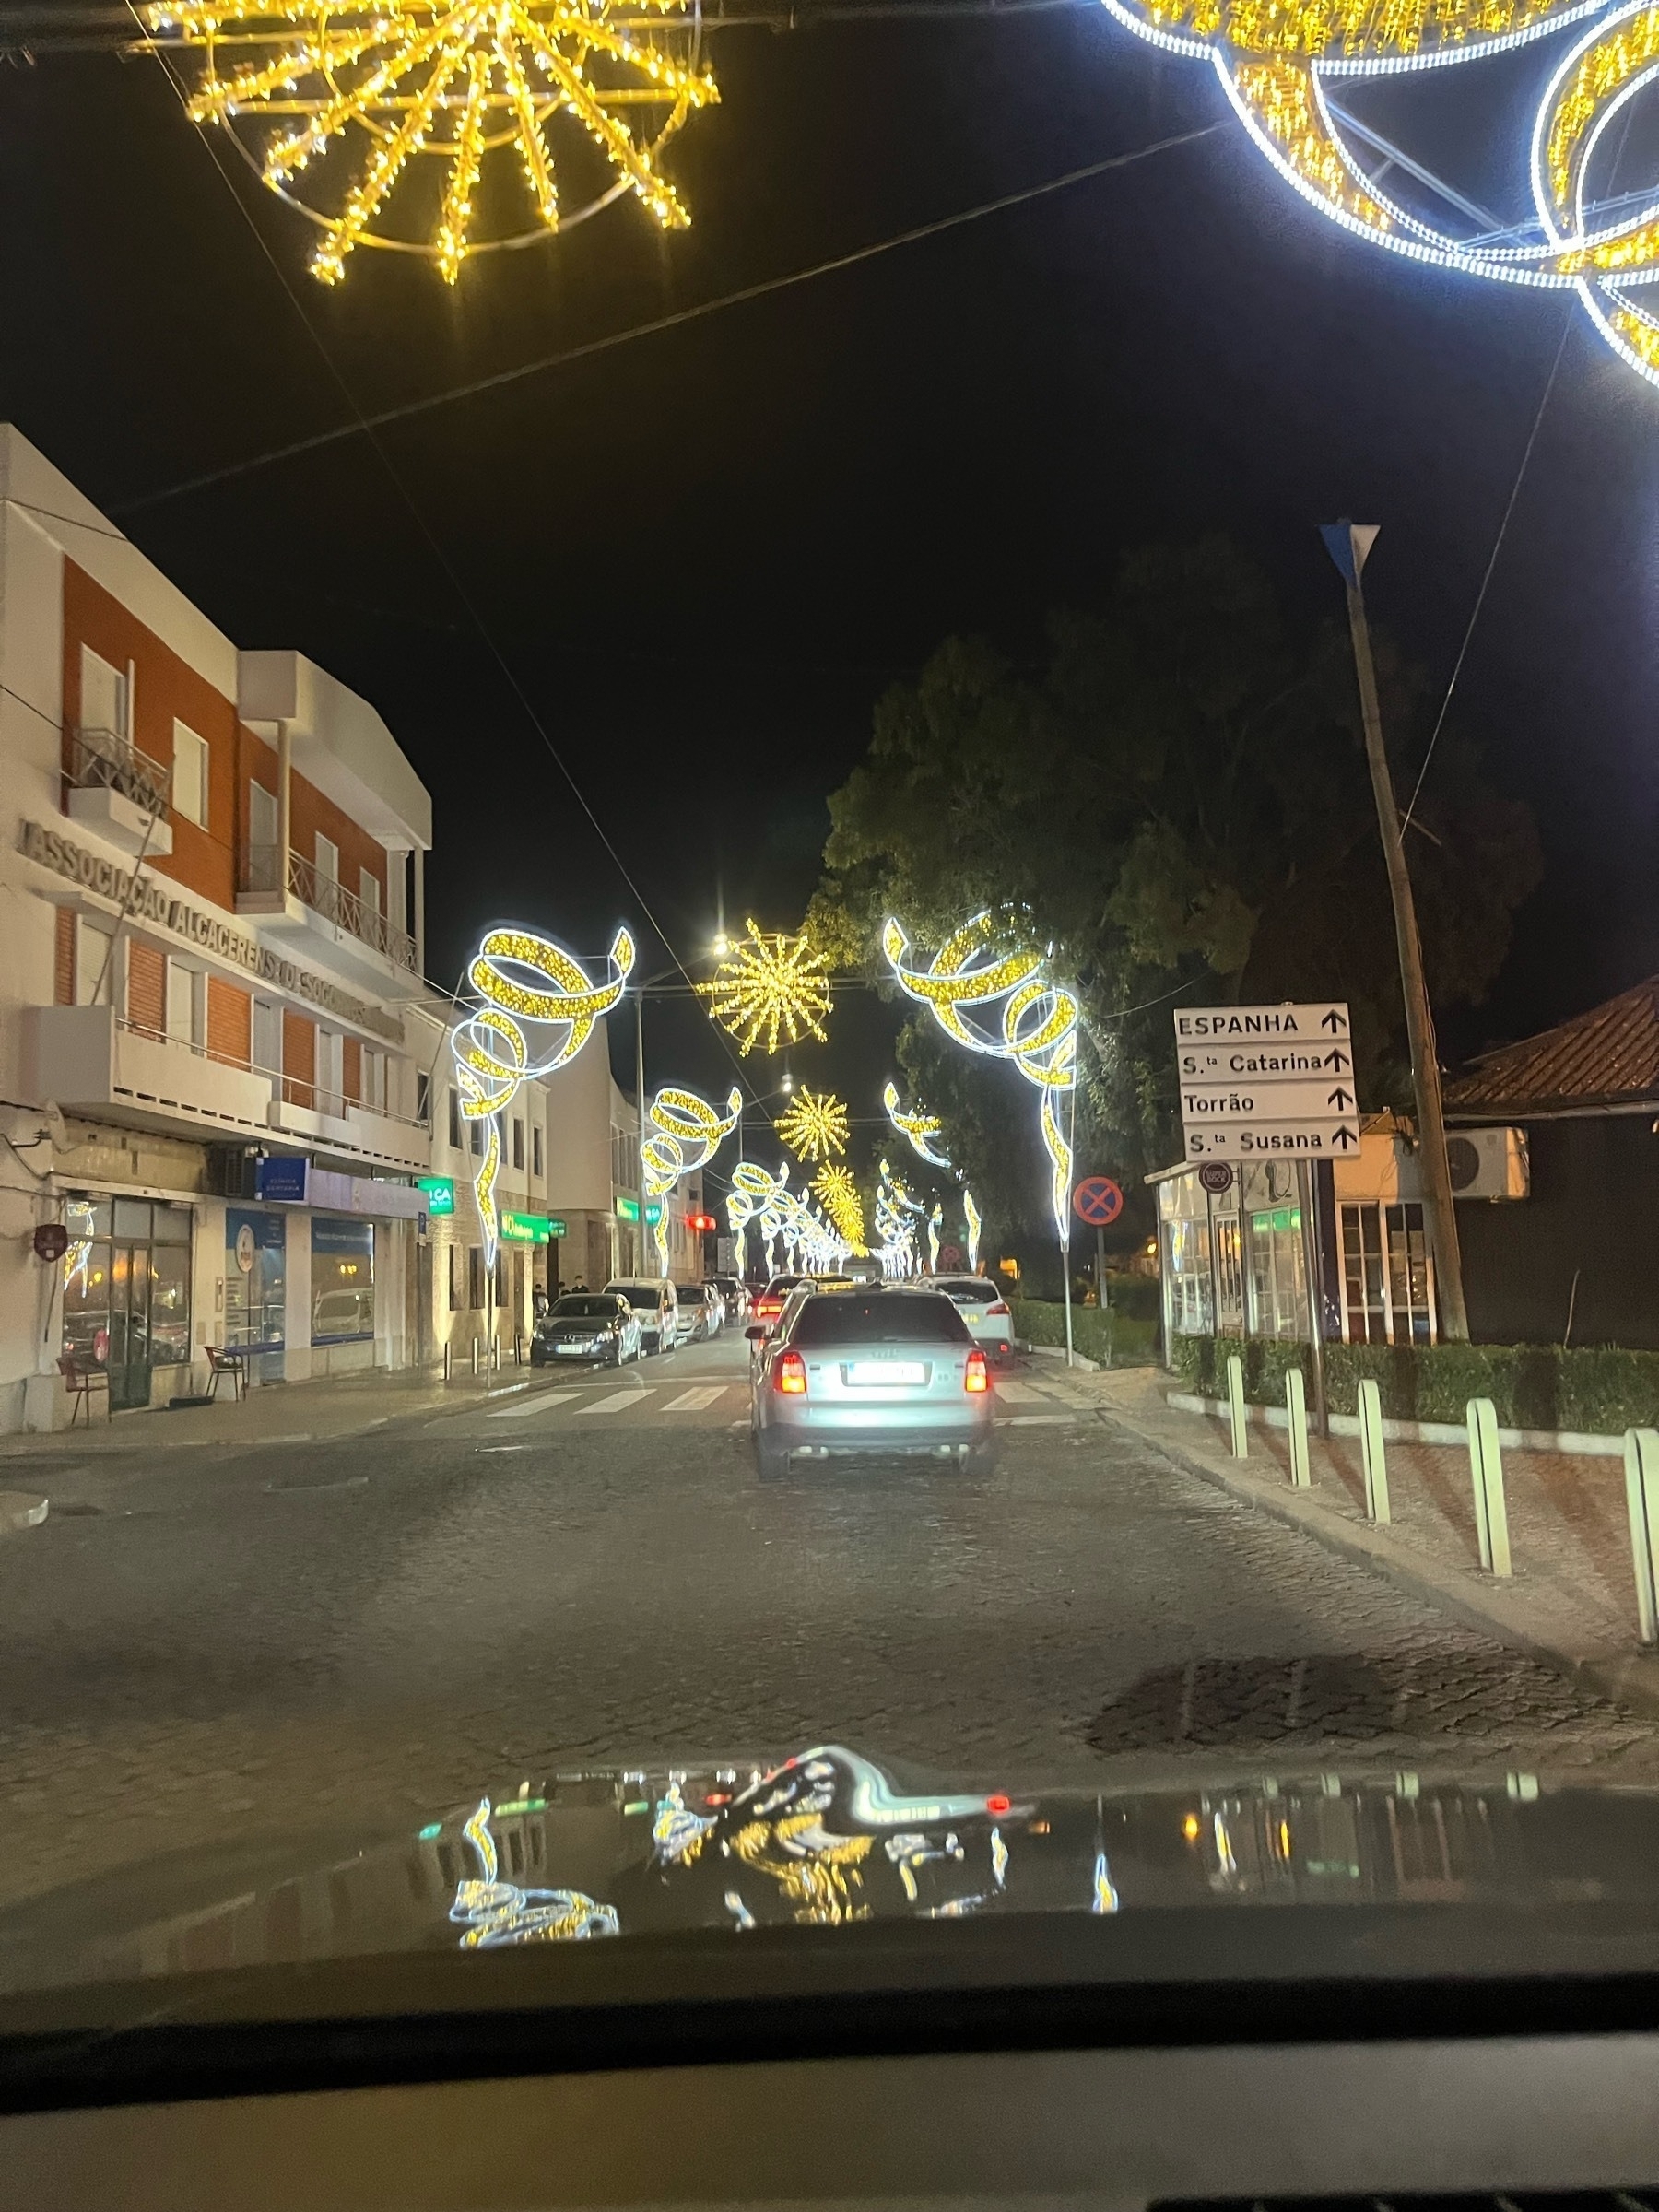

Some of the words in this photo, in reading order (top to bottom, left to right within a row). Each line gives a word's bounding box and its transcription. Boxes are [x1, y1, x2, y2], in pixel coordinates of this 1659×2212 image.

[1179, 1014, 1299, 1035] ESPANHA
[1230, 1053, 1322, 1072] Catarina
[1183, 1093, 1254, 1112] Torrão
[1241, 1132, 1323, 1150] Susana
